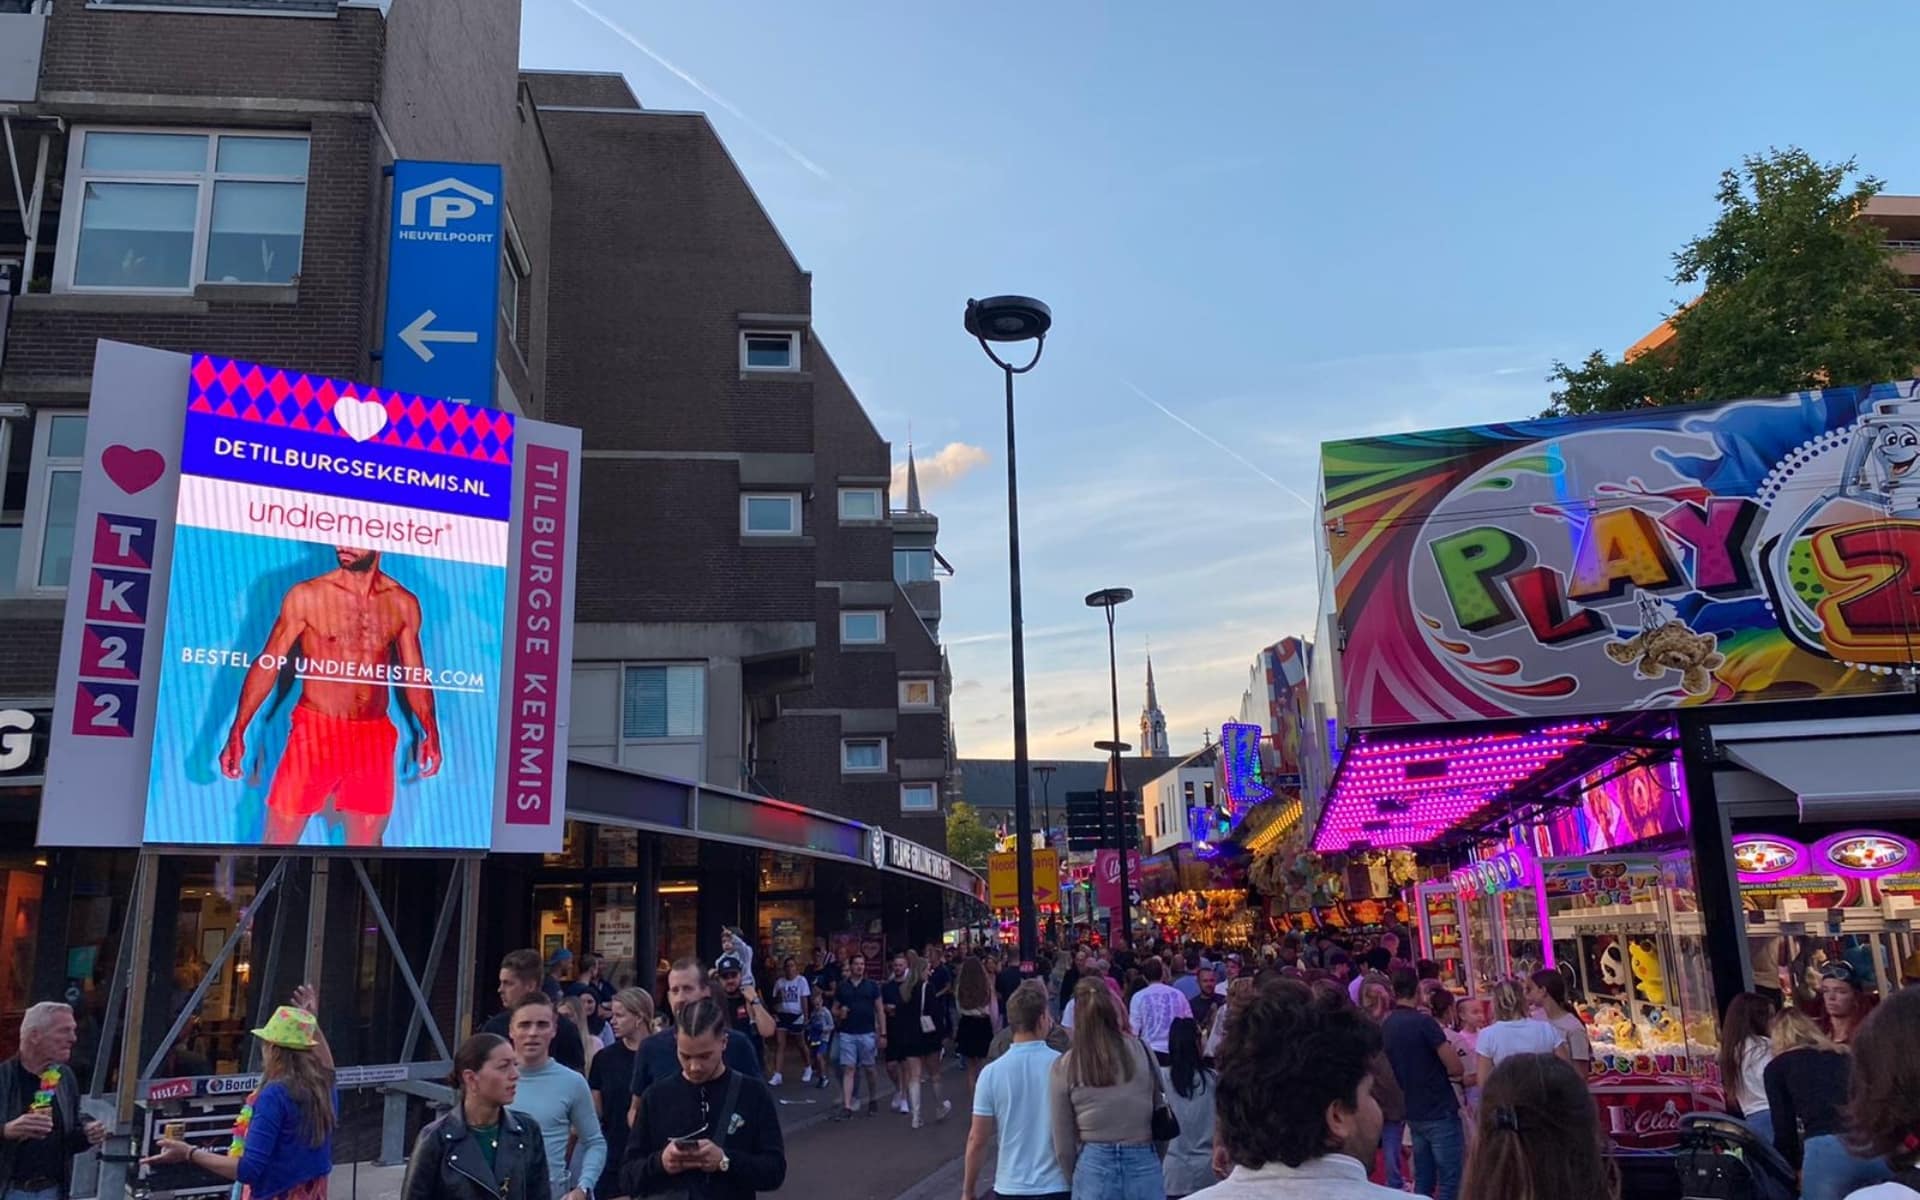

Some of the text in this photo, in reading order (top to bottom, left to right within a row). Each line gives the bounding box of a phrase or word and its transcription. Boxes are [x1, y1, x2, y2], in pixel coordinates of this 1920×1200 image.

[399, 230, 494, 243] HEUVELPOORT
[214, 437, 490, 497] DETILBURGSEKERMIS.NL
[1429, 497, 1767, 644] PLAY
[517, 461, 559, 811] TILBURGSE KERMIS
[181, 648, 484, 687] BESTEL OP UNDIEMEISTER.COM
